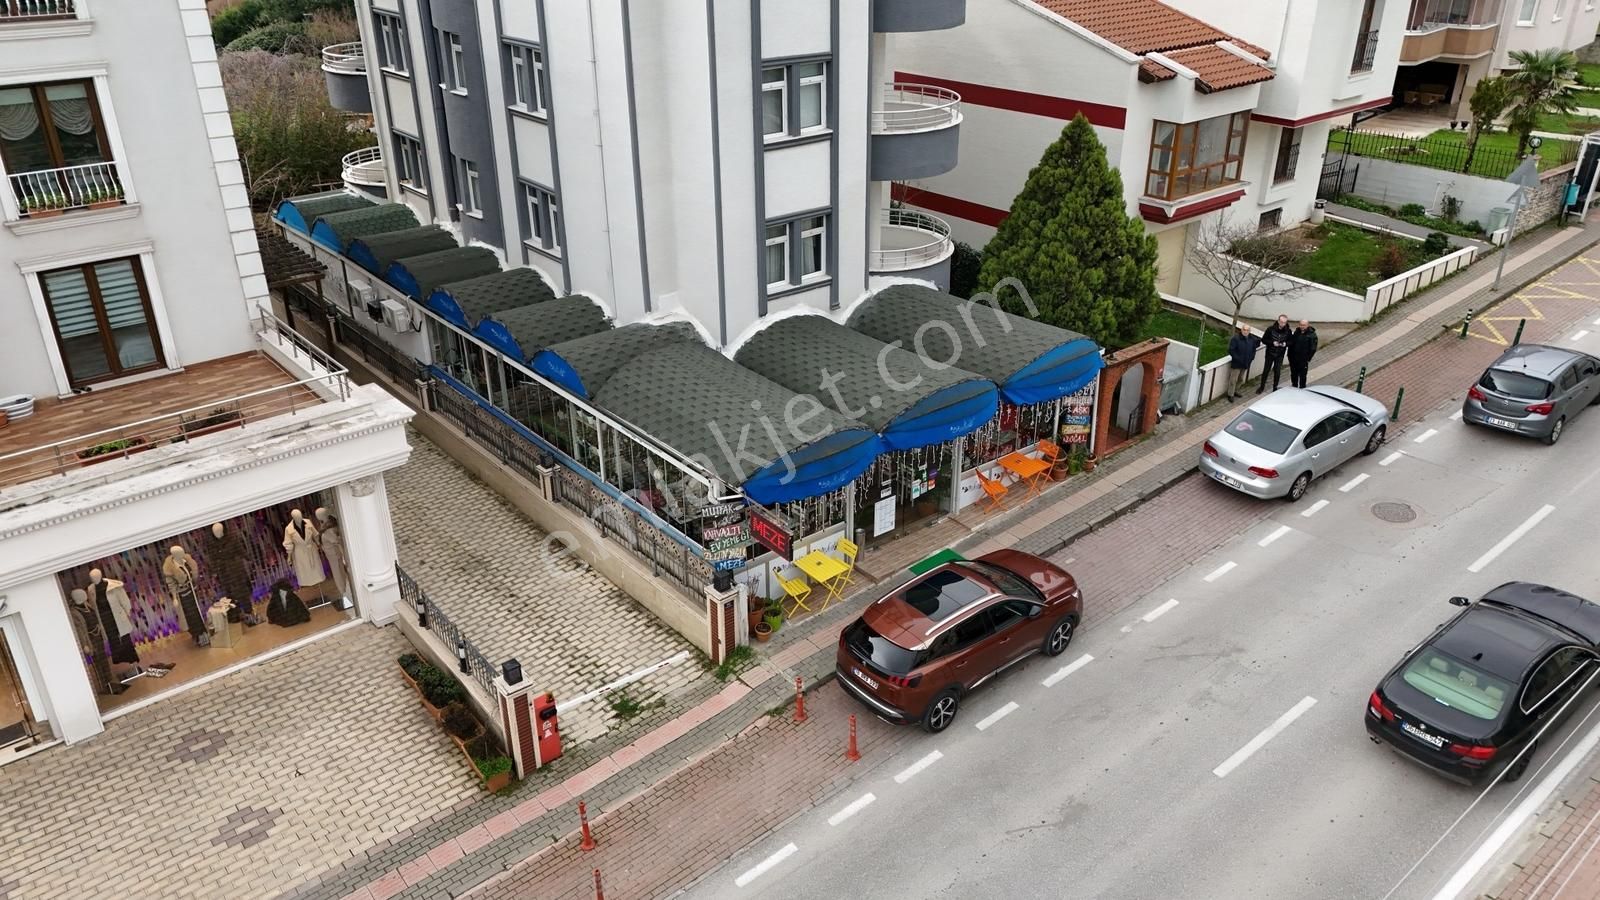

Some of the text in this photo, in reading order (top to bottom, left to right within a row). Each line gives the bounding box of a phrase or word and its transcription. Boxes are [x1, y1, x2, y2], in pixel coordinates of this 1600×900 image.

[701, 504, 734, 518] MUTFAK
[703, 526, 741, 541] KAHVALTI
[752, 516, 786, 552] MEZE
[710, 543, 721, 553] EV
